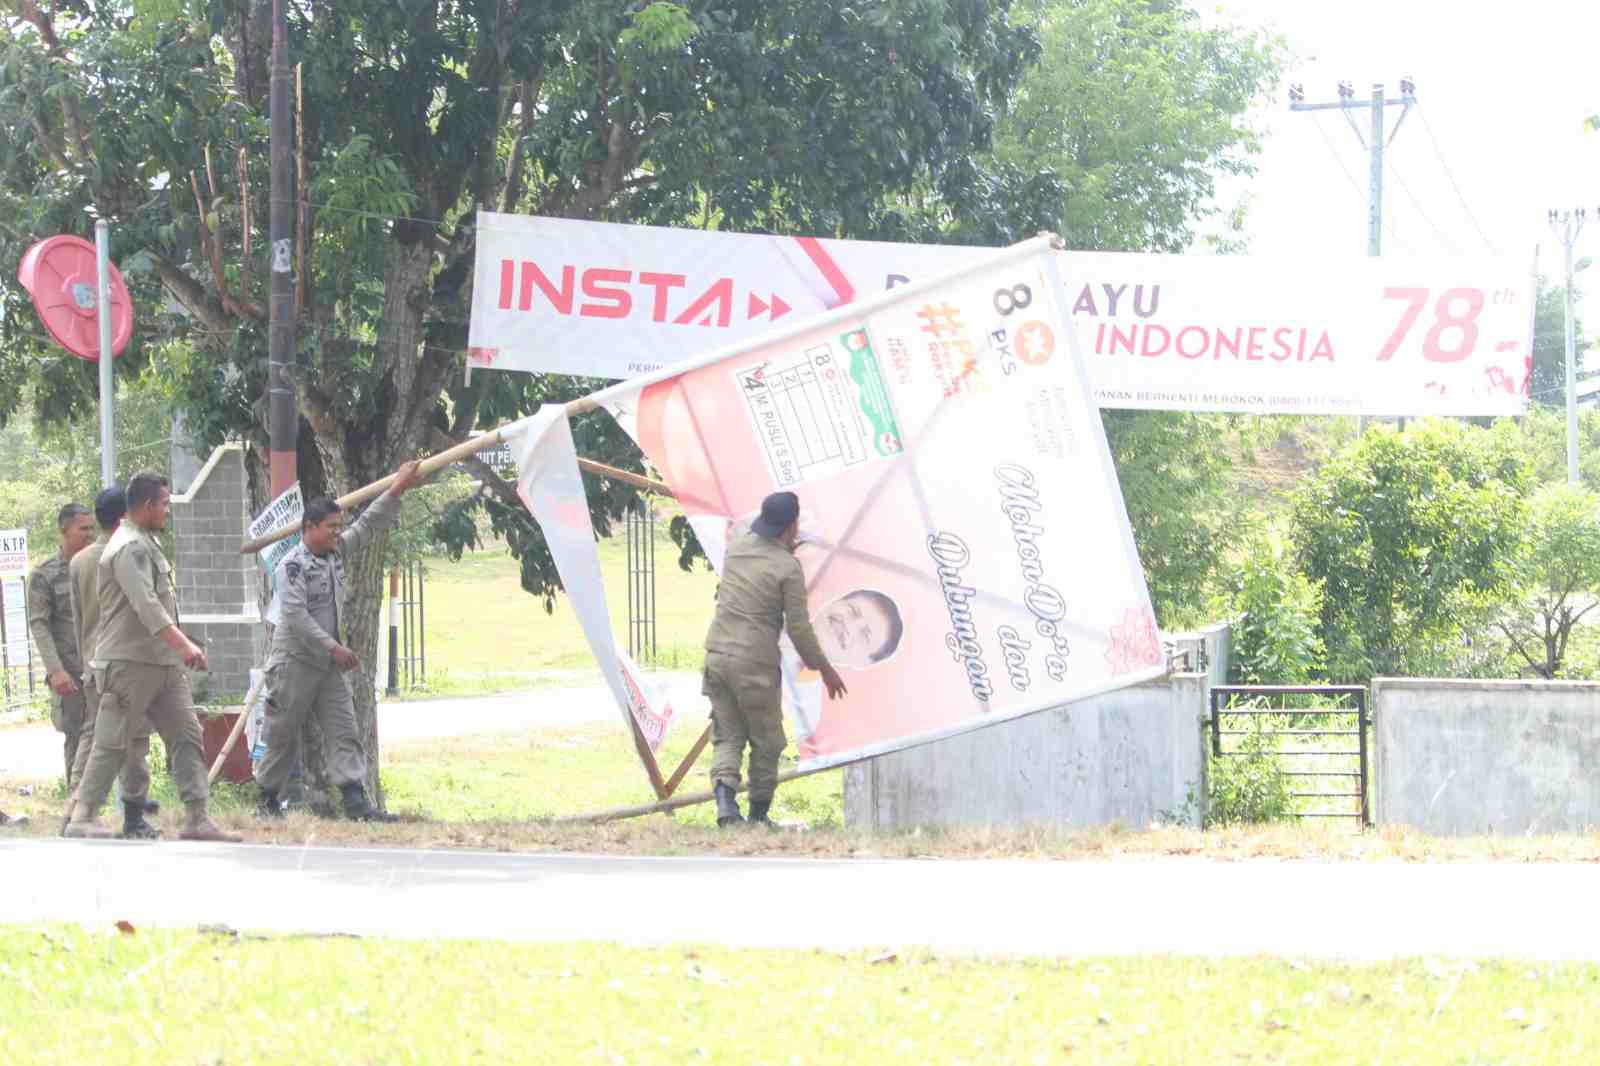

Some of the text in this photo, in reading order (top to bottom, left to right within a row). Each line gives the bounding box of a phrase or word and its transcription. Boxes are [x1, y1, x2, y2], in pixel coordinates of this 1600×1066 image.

[497, 258, 734, 328] INSTA
[993, 283, 1032, 316] 8
[991, 328, 1017, 376] PKS
[1094, 322, 1335, 362] INDONESIA
[1375, 286, 1485, 363] 78
[744, 376, 765, 391] 4
[926, 531, 994, 702] Dukungan
[997, 625, 1032, 692] dan
